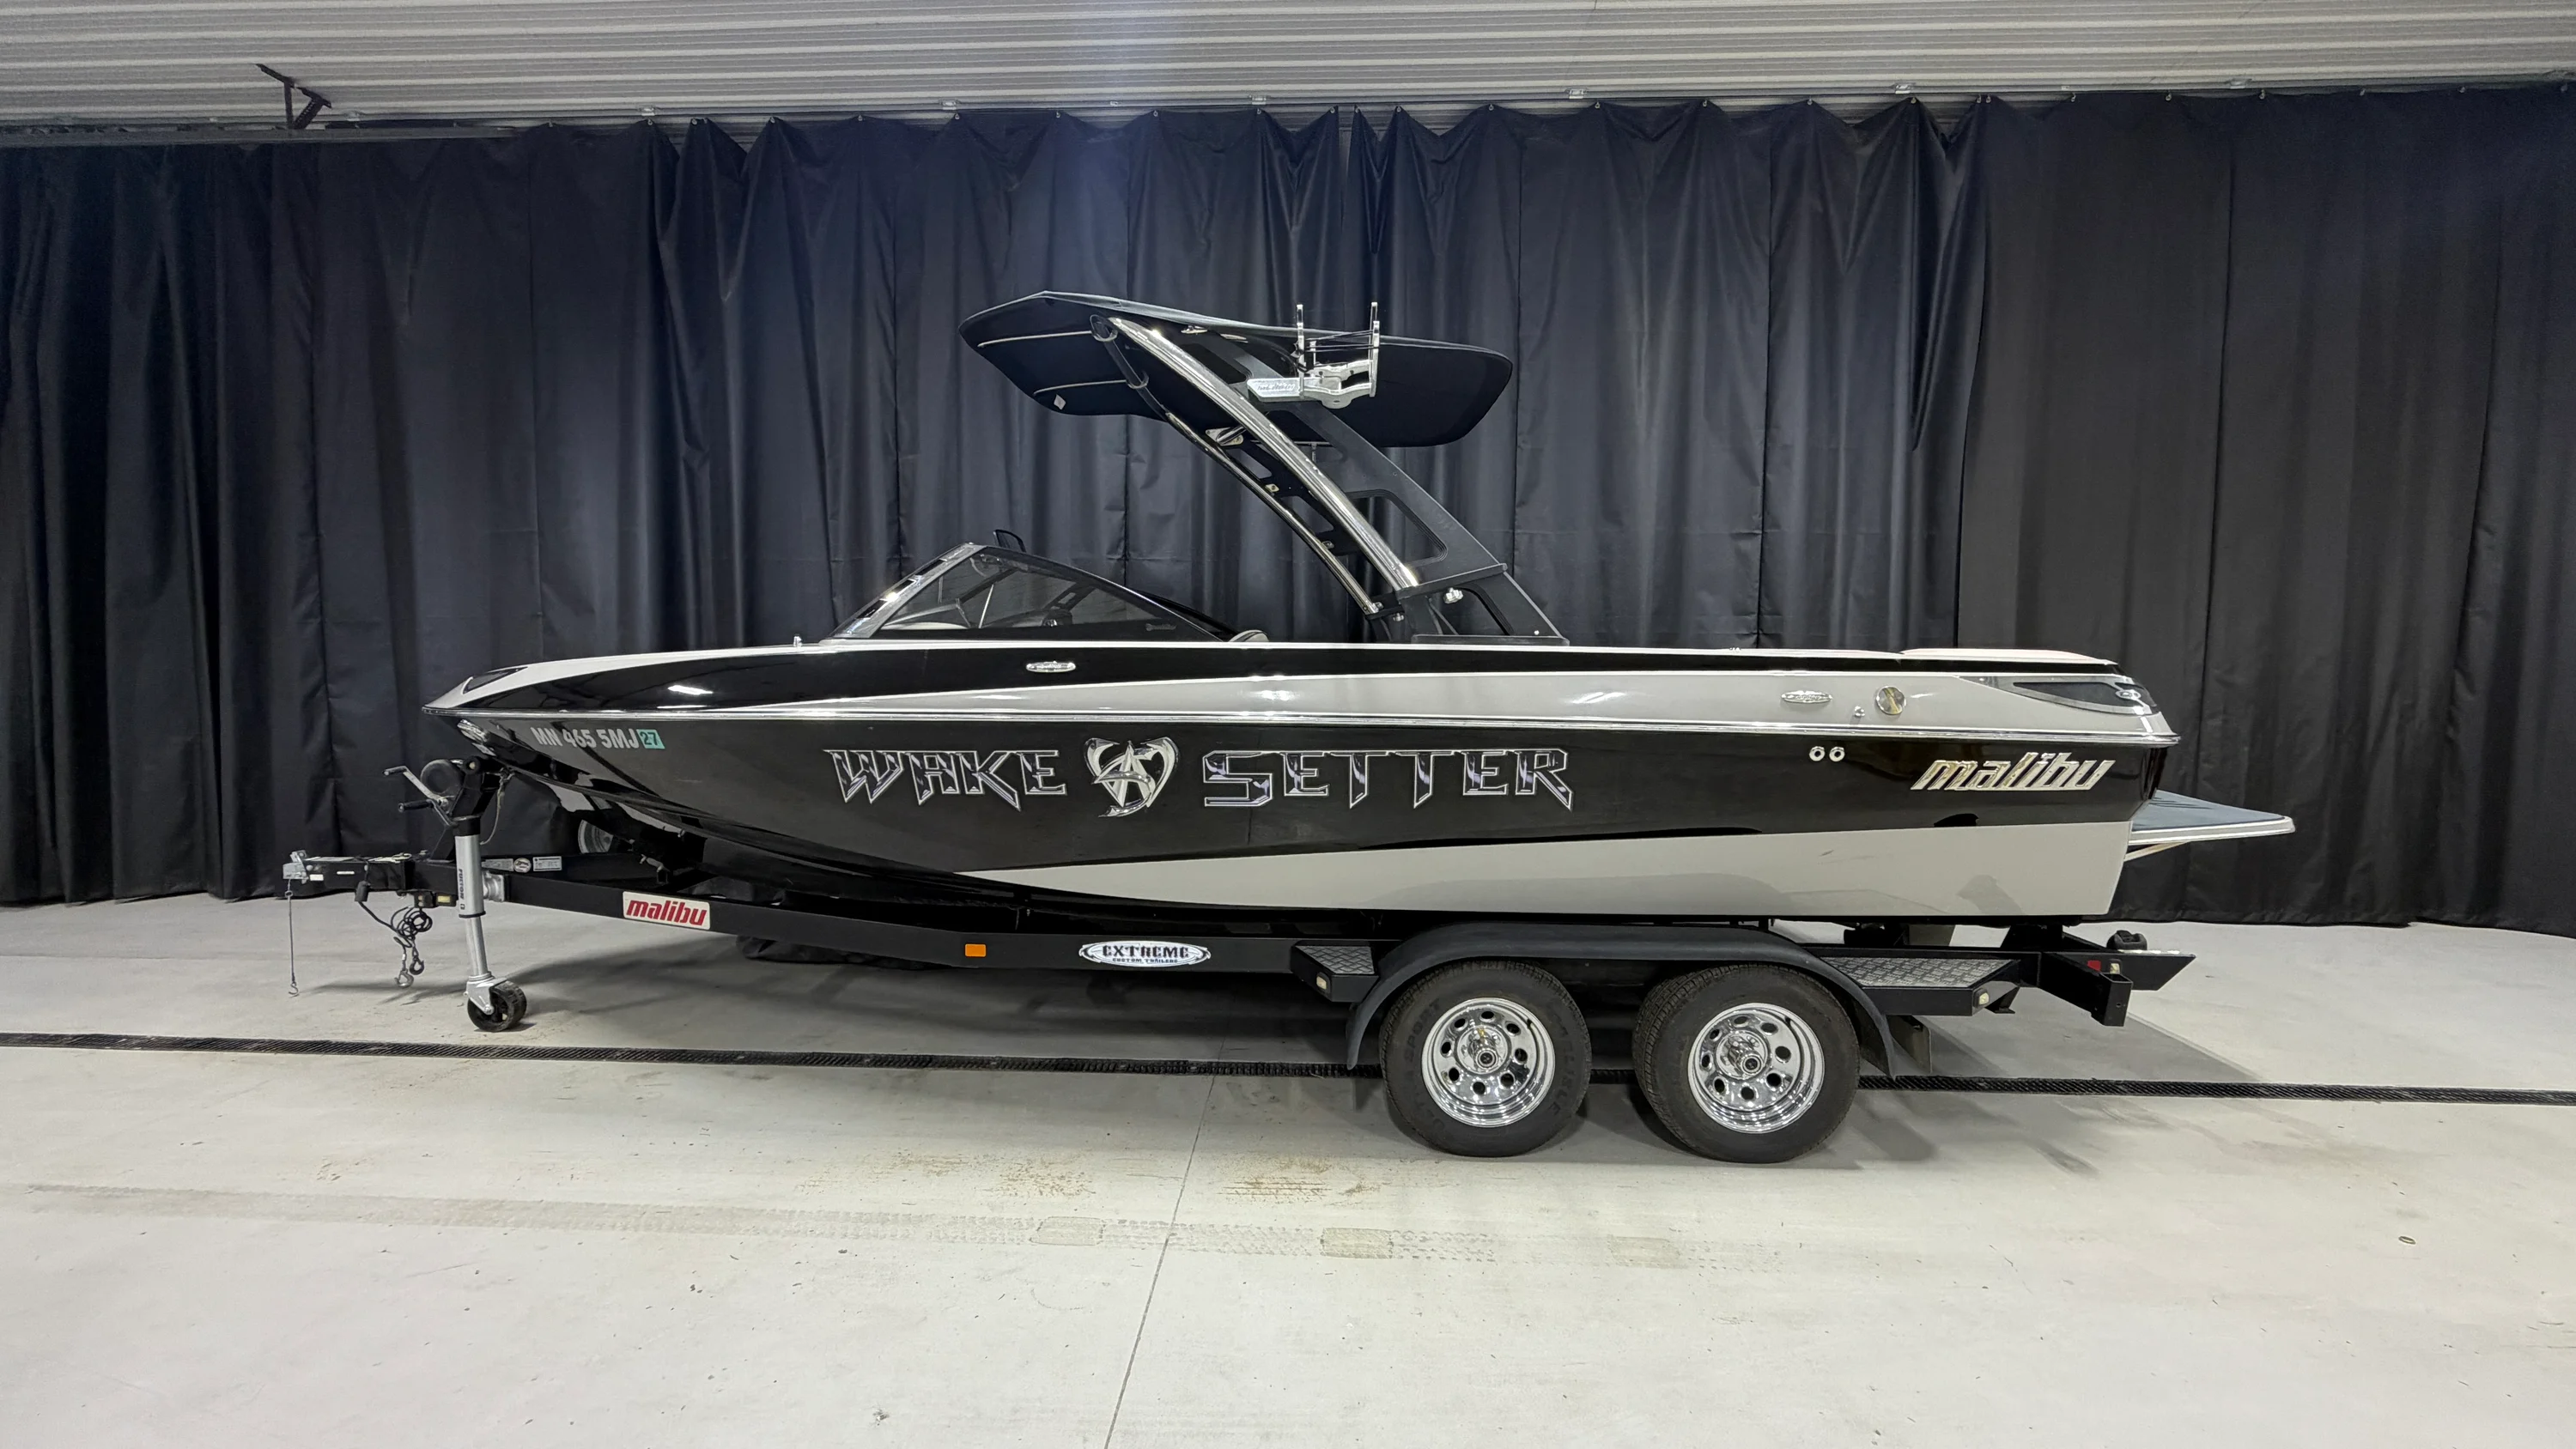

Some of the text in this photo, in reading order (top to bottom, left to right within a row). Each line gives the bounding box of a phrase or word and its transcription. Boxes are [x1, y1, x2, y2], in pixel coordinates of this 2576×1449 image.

[530, 726, 640, 749] MN 465 5MJ
[640, 731, 658, 746] 27
[823, 749, 1574, 812] WAKE SETTER
[1911, 751, 2117, 791] malibu
[626, 900, 708, 926] malibu
[1102, 945, 1189, 959] EXTREME
